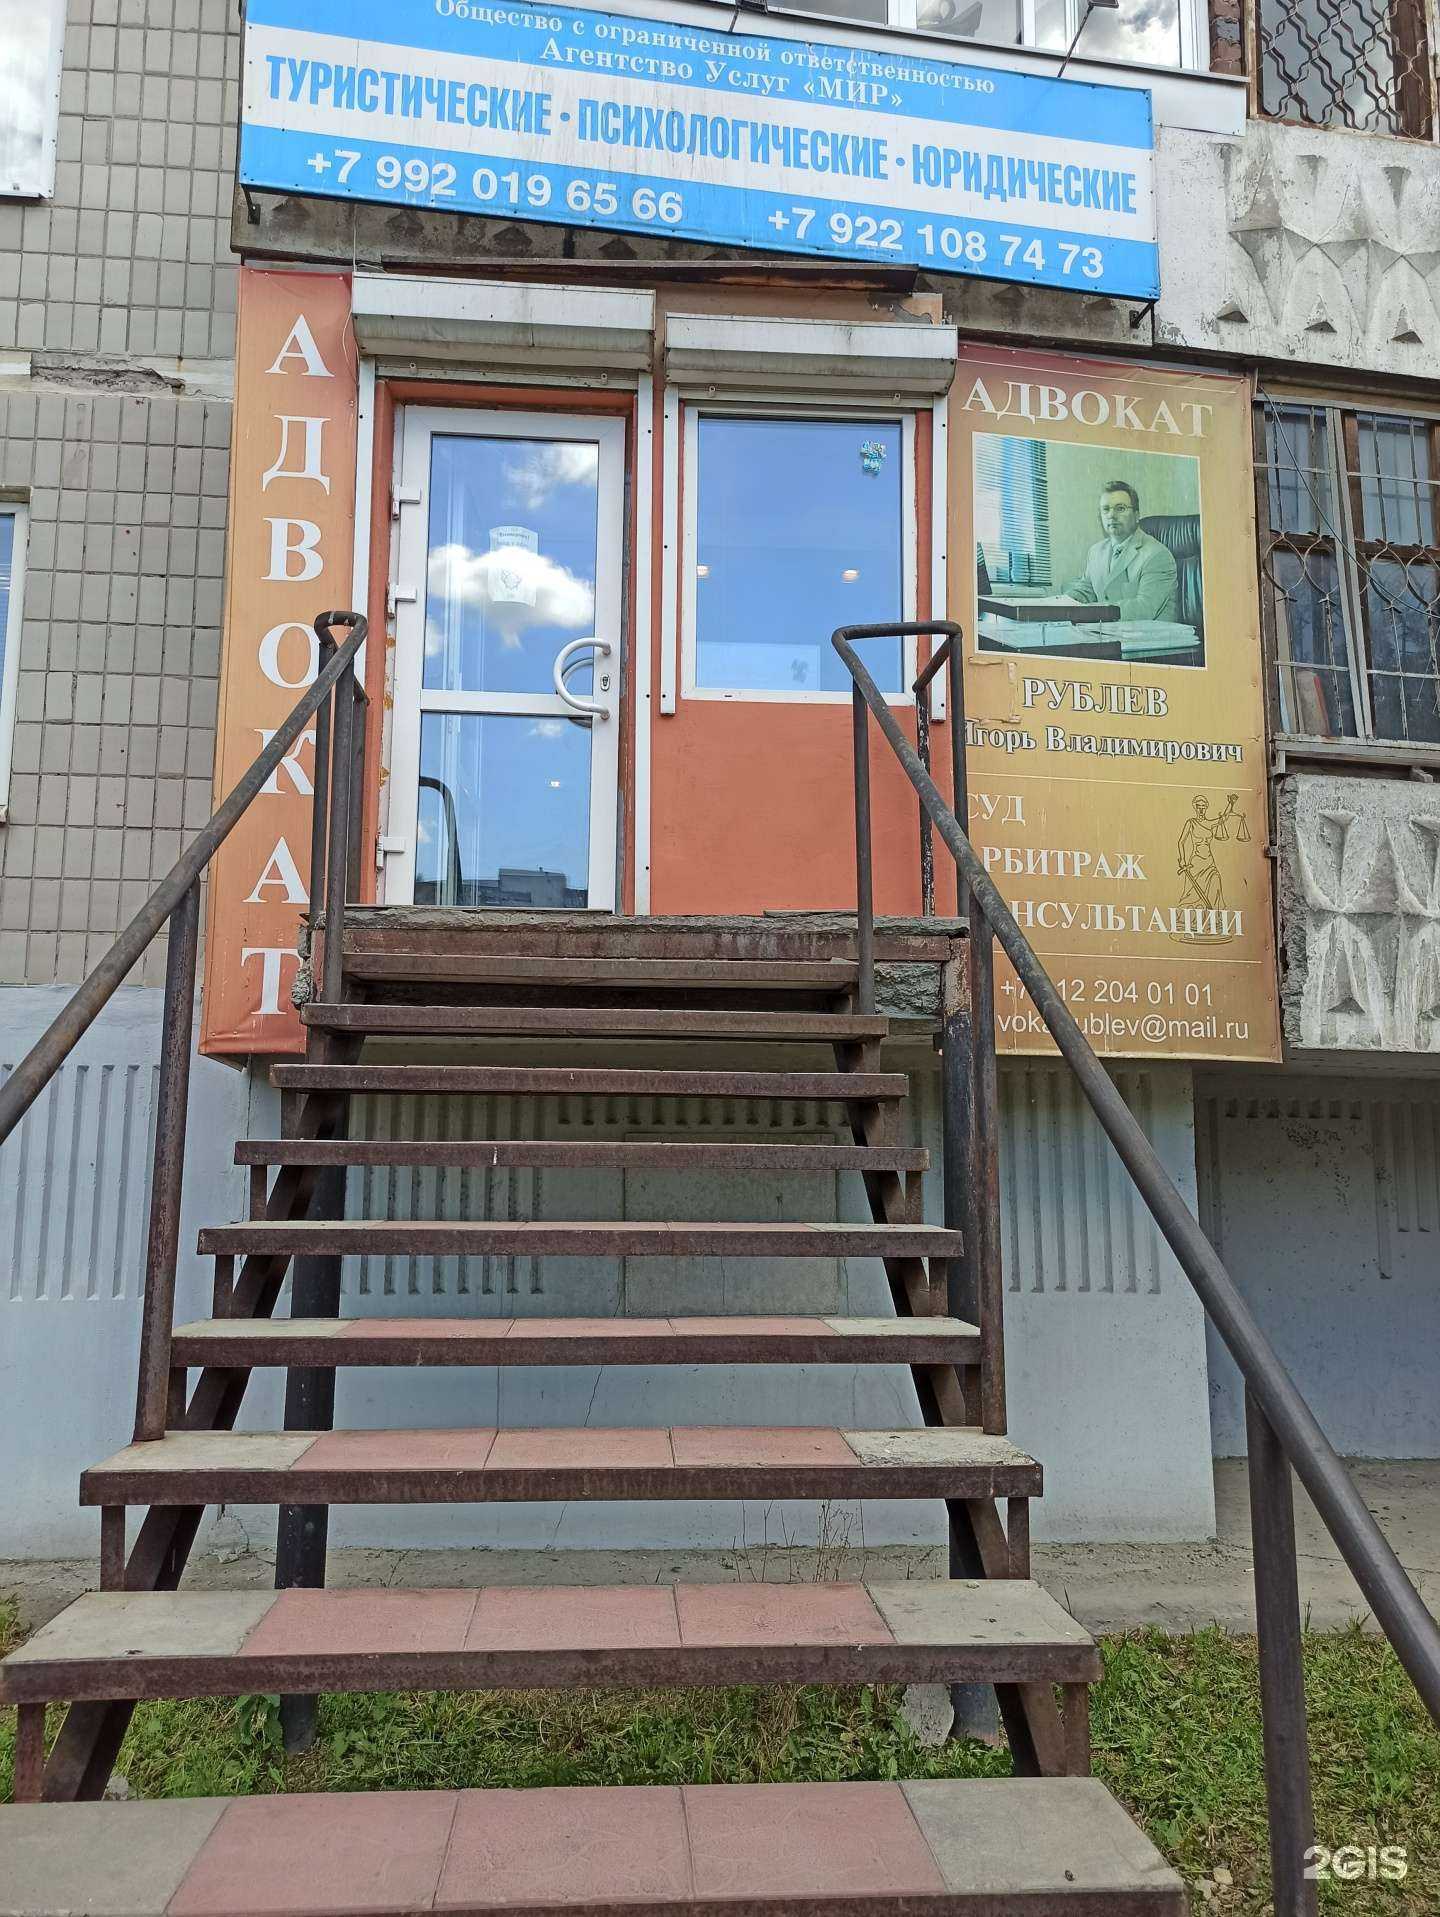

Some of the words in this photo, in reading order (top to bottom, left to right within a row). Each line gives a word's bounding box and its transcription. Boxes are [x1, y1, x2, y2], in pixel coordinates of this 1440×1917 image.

[434, 0, 563, 33] Общество
[572, 20, 585, 36] с
[594, 23, 770, 62] ограниченной
[780, 48, 996, 94] ответственностью
[539, 37, 693, 80] Агентство
[704, 59, 790, 96] Услуг
[803, 75, 903, 107] «МИР»
[265, 54, 552, 136] ТУРИСТИЧЕСКИЕ
[578, 98, 889, 181] ПСИХОЛОГИЧЕСКИЕ
[912, 143, 1137, 215] ЮРИДИЧЕСКИЕ
[307, 148, 362, 184] +7
[376, 155, 457, 197] 992
[472, 167, 553, 207] 019
[566, 180, 618, 215] 65
[631, 187, 683, 224] 66
[768, 208, 816, 240] +7
[830, 216, 904, 251] 922
[917, 225, 986, 263] 108
[1000, 236, 1045, 271] 74
[1058, 243, 1104, 279] 73
[961, 377, 1214, 438] АДВОКАТ
[1021, 677, 1170, 718] РУБЛЕВ
[1045, 725, 1244, 764] Владимирович
[980, 846, 1148, 881] РБИТРАЖ
[1009, 900, 1245, 937] НСУЛЬТАЦИИ
[1056, 978, 1086, 1003] 12
[1093, 980, 1140, 1004] 204
[1147, 981, 1176, 1006] 01
[1185, 983, 1213, 1007] 01
